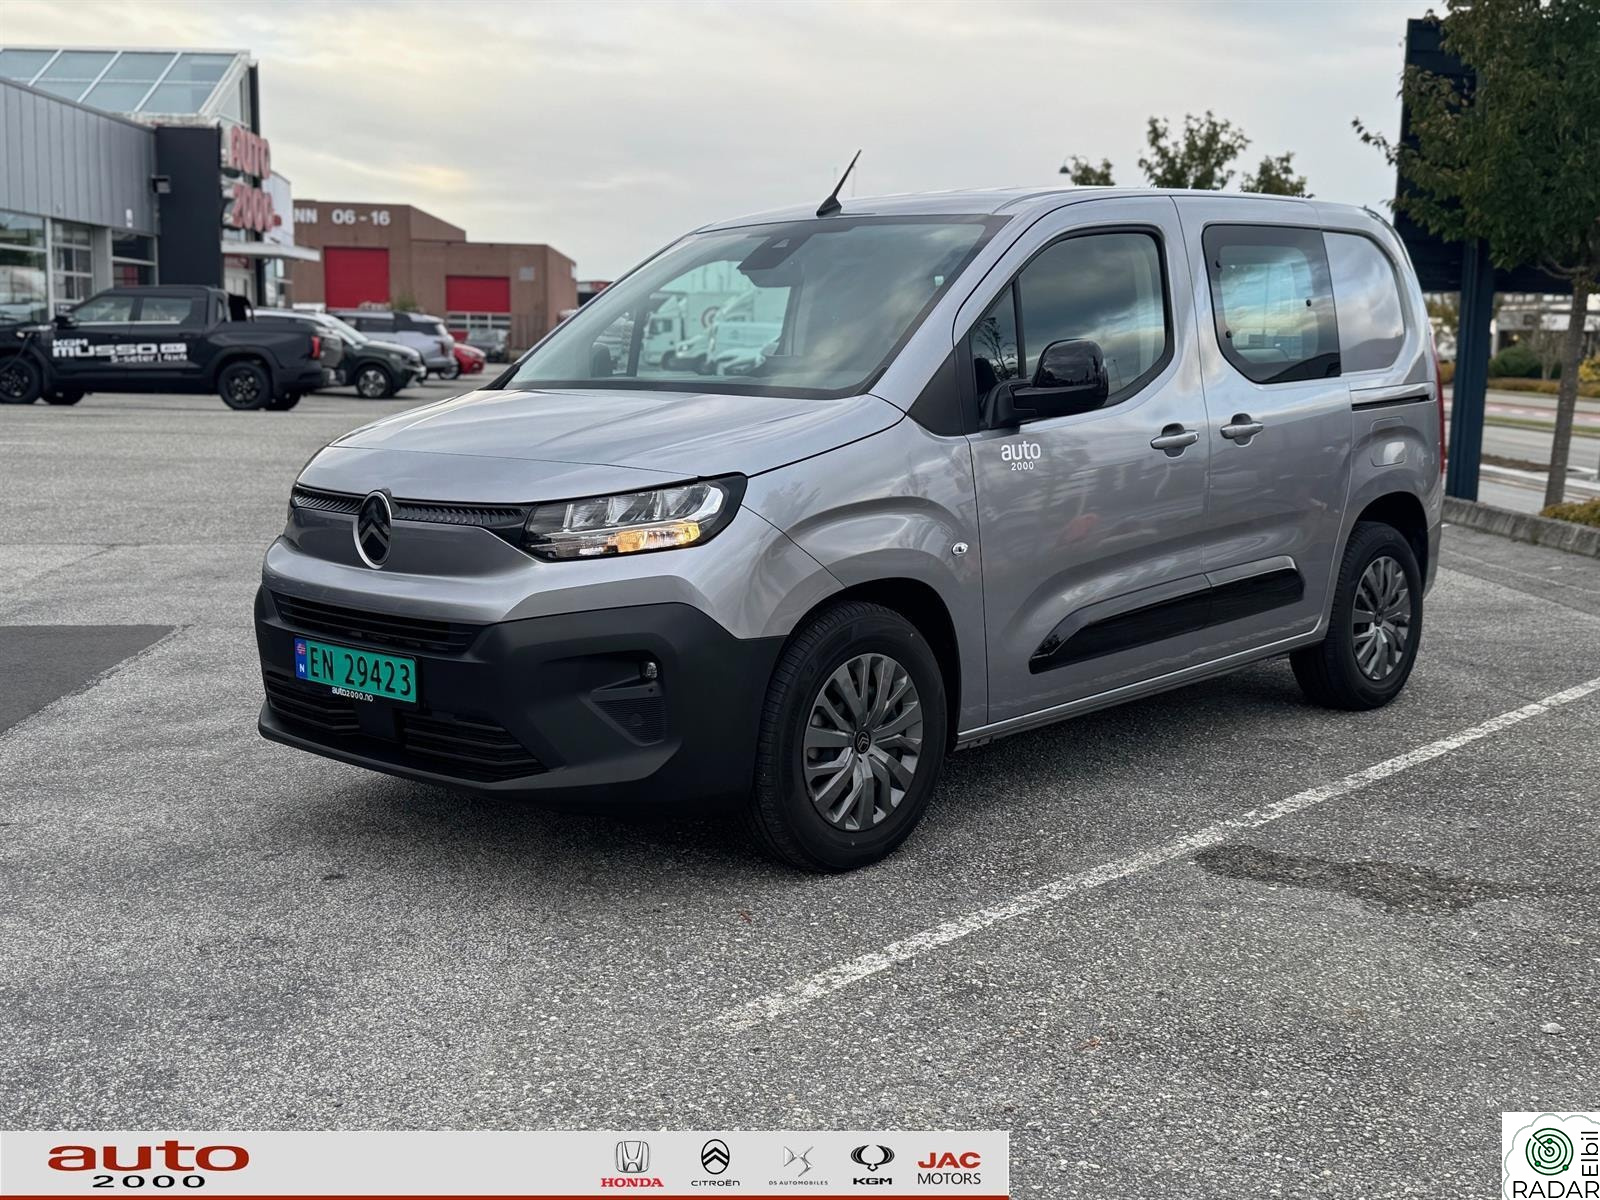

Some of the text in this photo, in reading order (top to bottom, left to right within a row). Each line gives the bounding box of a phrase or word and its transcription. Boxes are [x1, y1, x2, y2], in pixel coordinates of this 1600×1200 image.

[230, 125, 271, 180] AUTO
[231, 184, 273, 232] 2000
[332, 209, 356, 224] 06
[371, 210, 390, 225] 16
[1001, 440, 1041, 461] auto
[1011, 461, 1034, 471] 2000
[310, 648, 411, 696] EN 29423
[331, 686, 374, 702] auto2000.no
